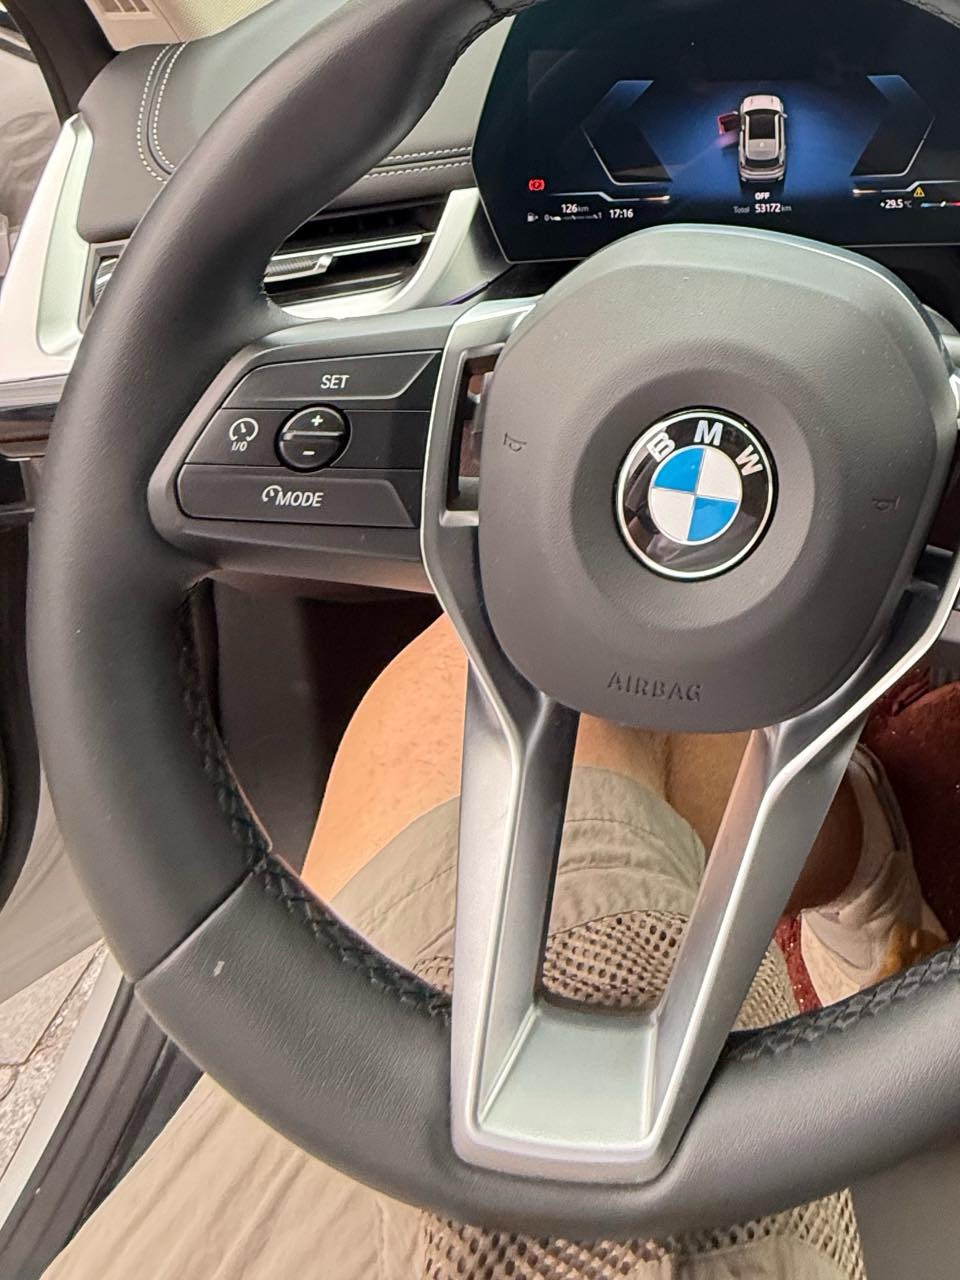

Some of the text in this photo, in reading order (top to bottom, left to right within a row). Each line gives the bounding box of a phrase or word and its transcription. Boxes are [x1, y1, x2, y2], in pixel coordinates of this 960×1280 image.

[755, 191, 770, 200] OFF
[561, 204, 577, 213] 126
[609, 209, 634, 218] 17:16
[733, 205, 750, 214] Total
[755, 203, 781, 213] 53172
[320, 374, 349, 389] SET
[646, 419, 764, 477] BMW
[275, 491, 324, 507] MODE
[606, 671, 701, 703] AIRBAG
